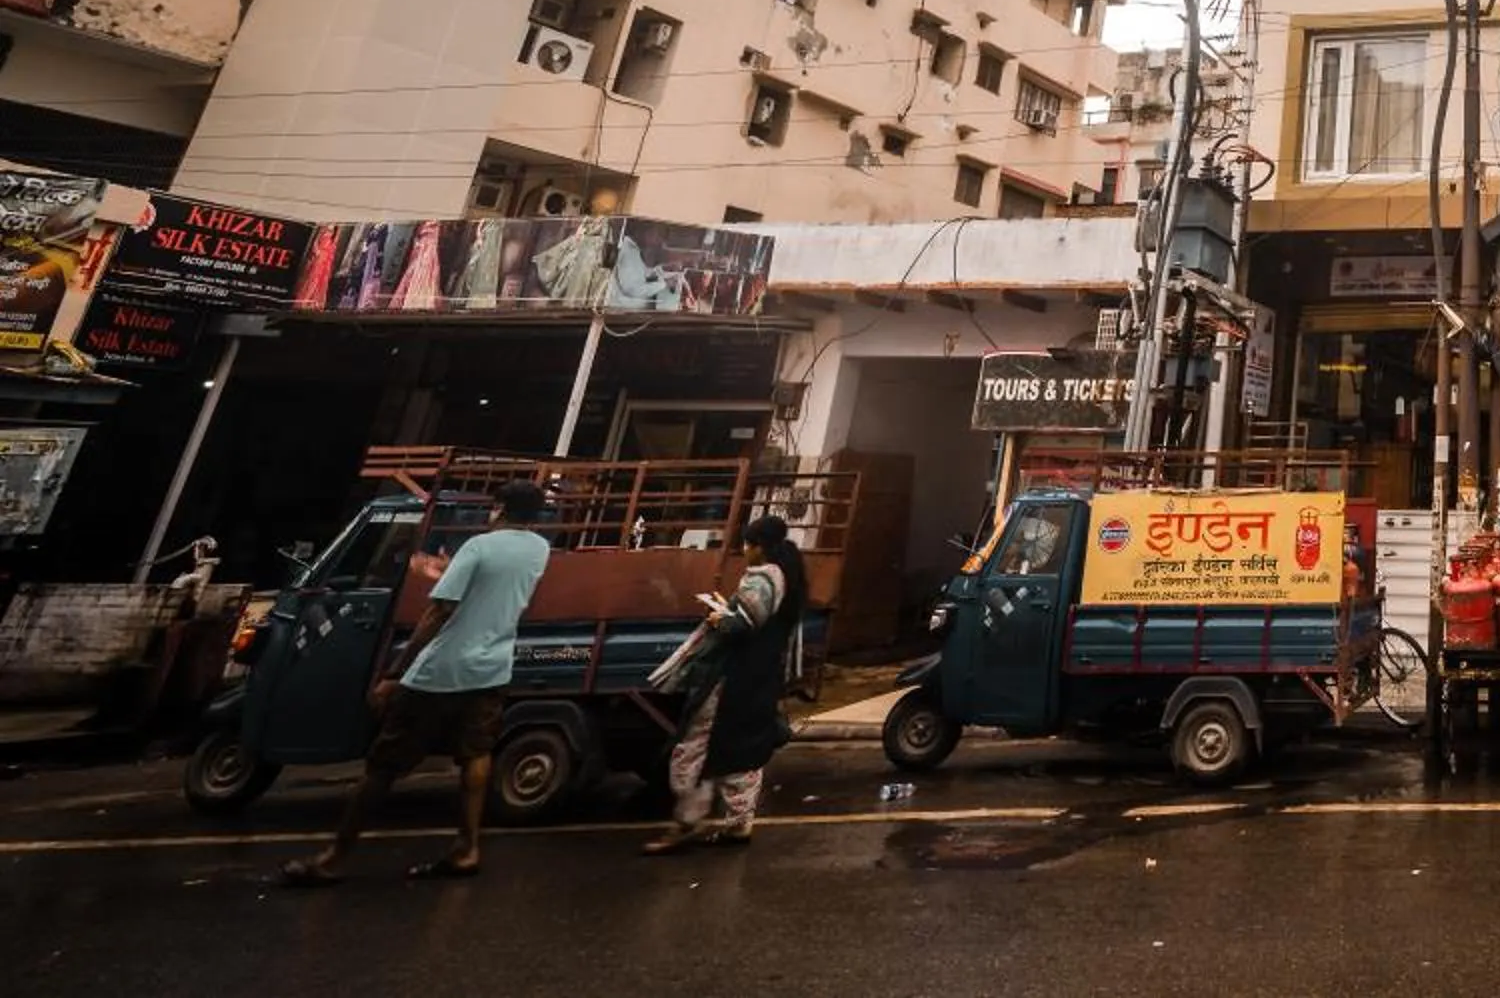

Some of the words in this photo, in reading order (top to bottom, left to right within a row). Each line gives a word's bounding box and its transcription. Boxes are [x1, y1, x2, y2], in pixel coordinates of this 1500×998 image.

[186, 205, 284, 241] KHIZAR
[153, 227, 212, 256] SILK
[213, 238, 293, 270] ESTATE
[983, 378, 1041, 401] TOURS
[1044, 379, 1057, 401] &
[1063, 379, 1138, 402] TICKETS
[1146, 501, 1276, 557] इण्डेन
